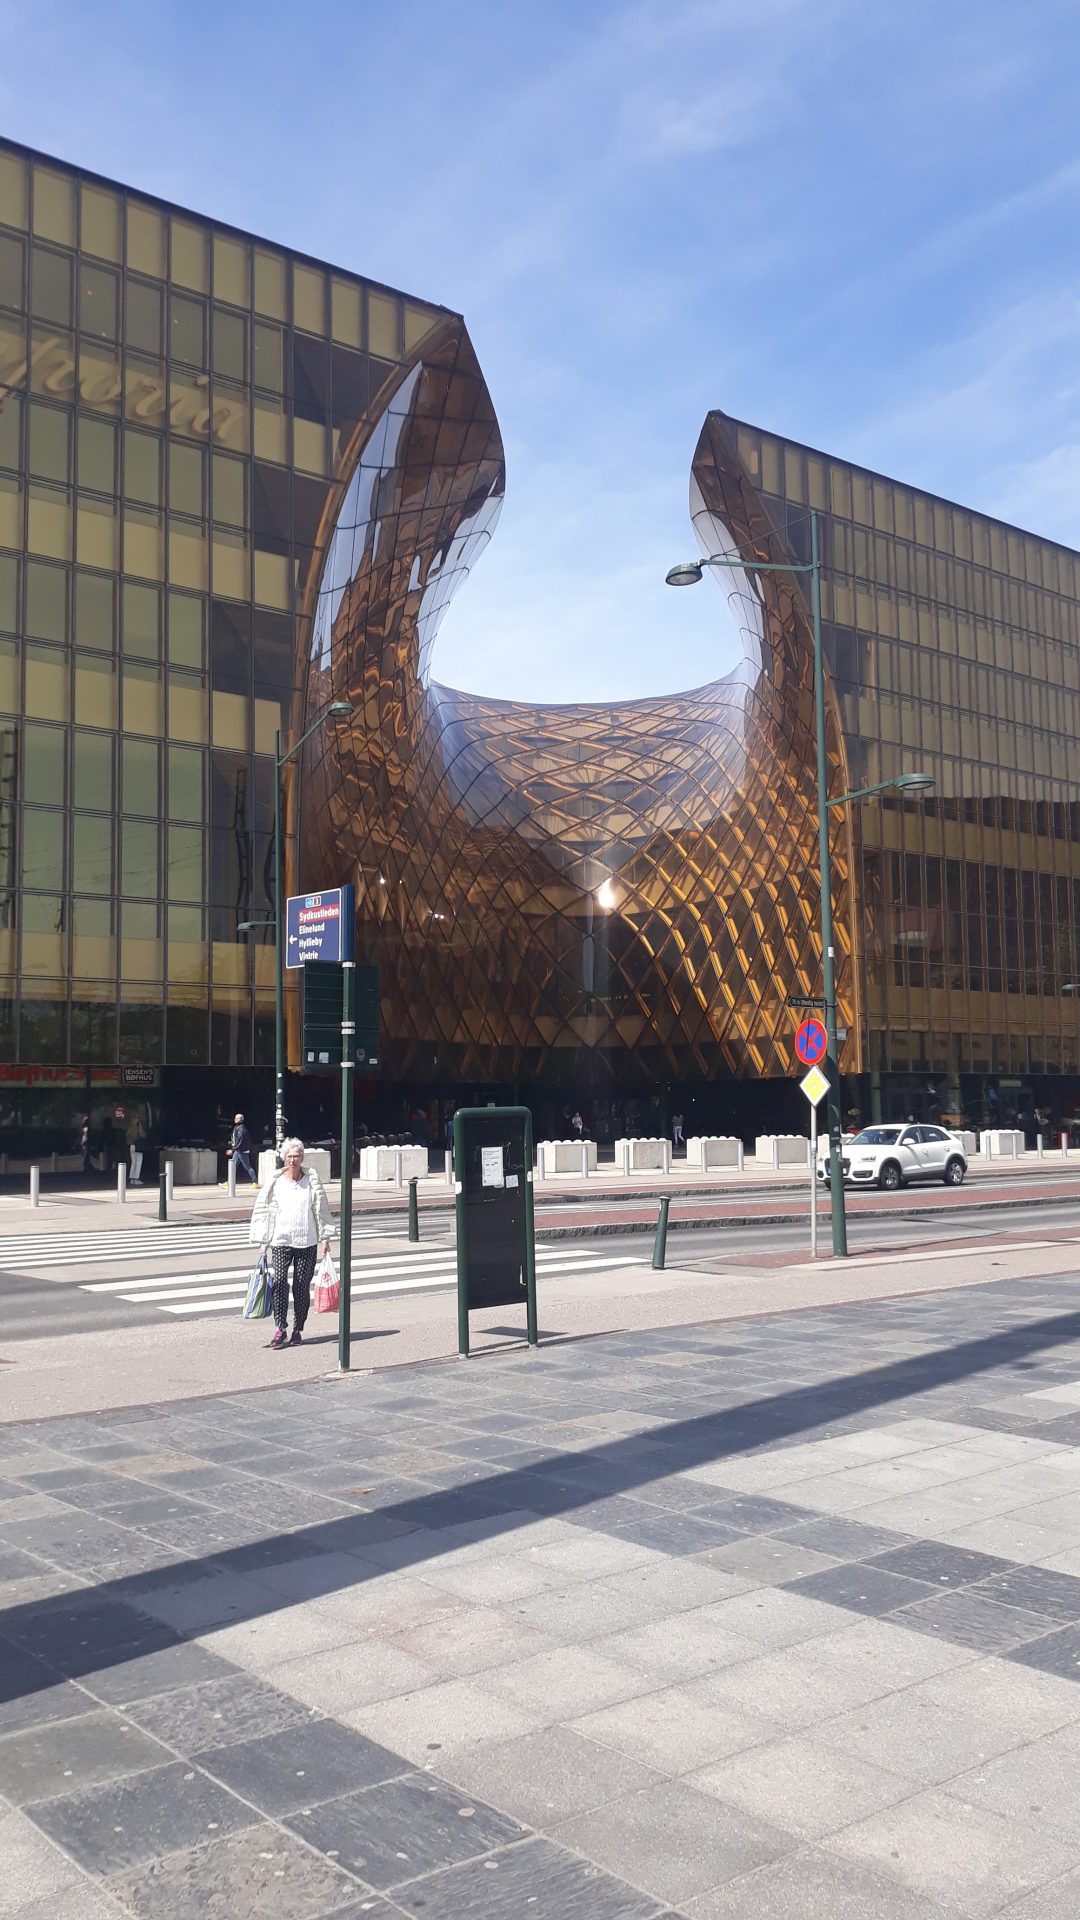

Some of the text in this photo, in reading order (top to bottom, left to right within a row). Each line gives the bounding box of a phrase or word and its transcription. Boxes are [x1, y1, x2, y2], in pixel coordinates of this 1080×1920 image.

[299, 908, 339, 922] Sydkustleden
[299, 922, 325, 934] Elinelund
[299, 937, 322, 949] Hyllieby
[299, 950, 318, 961] Vintrie
